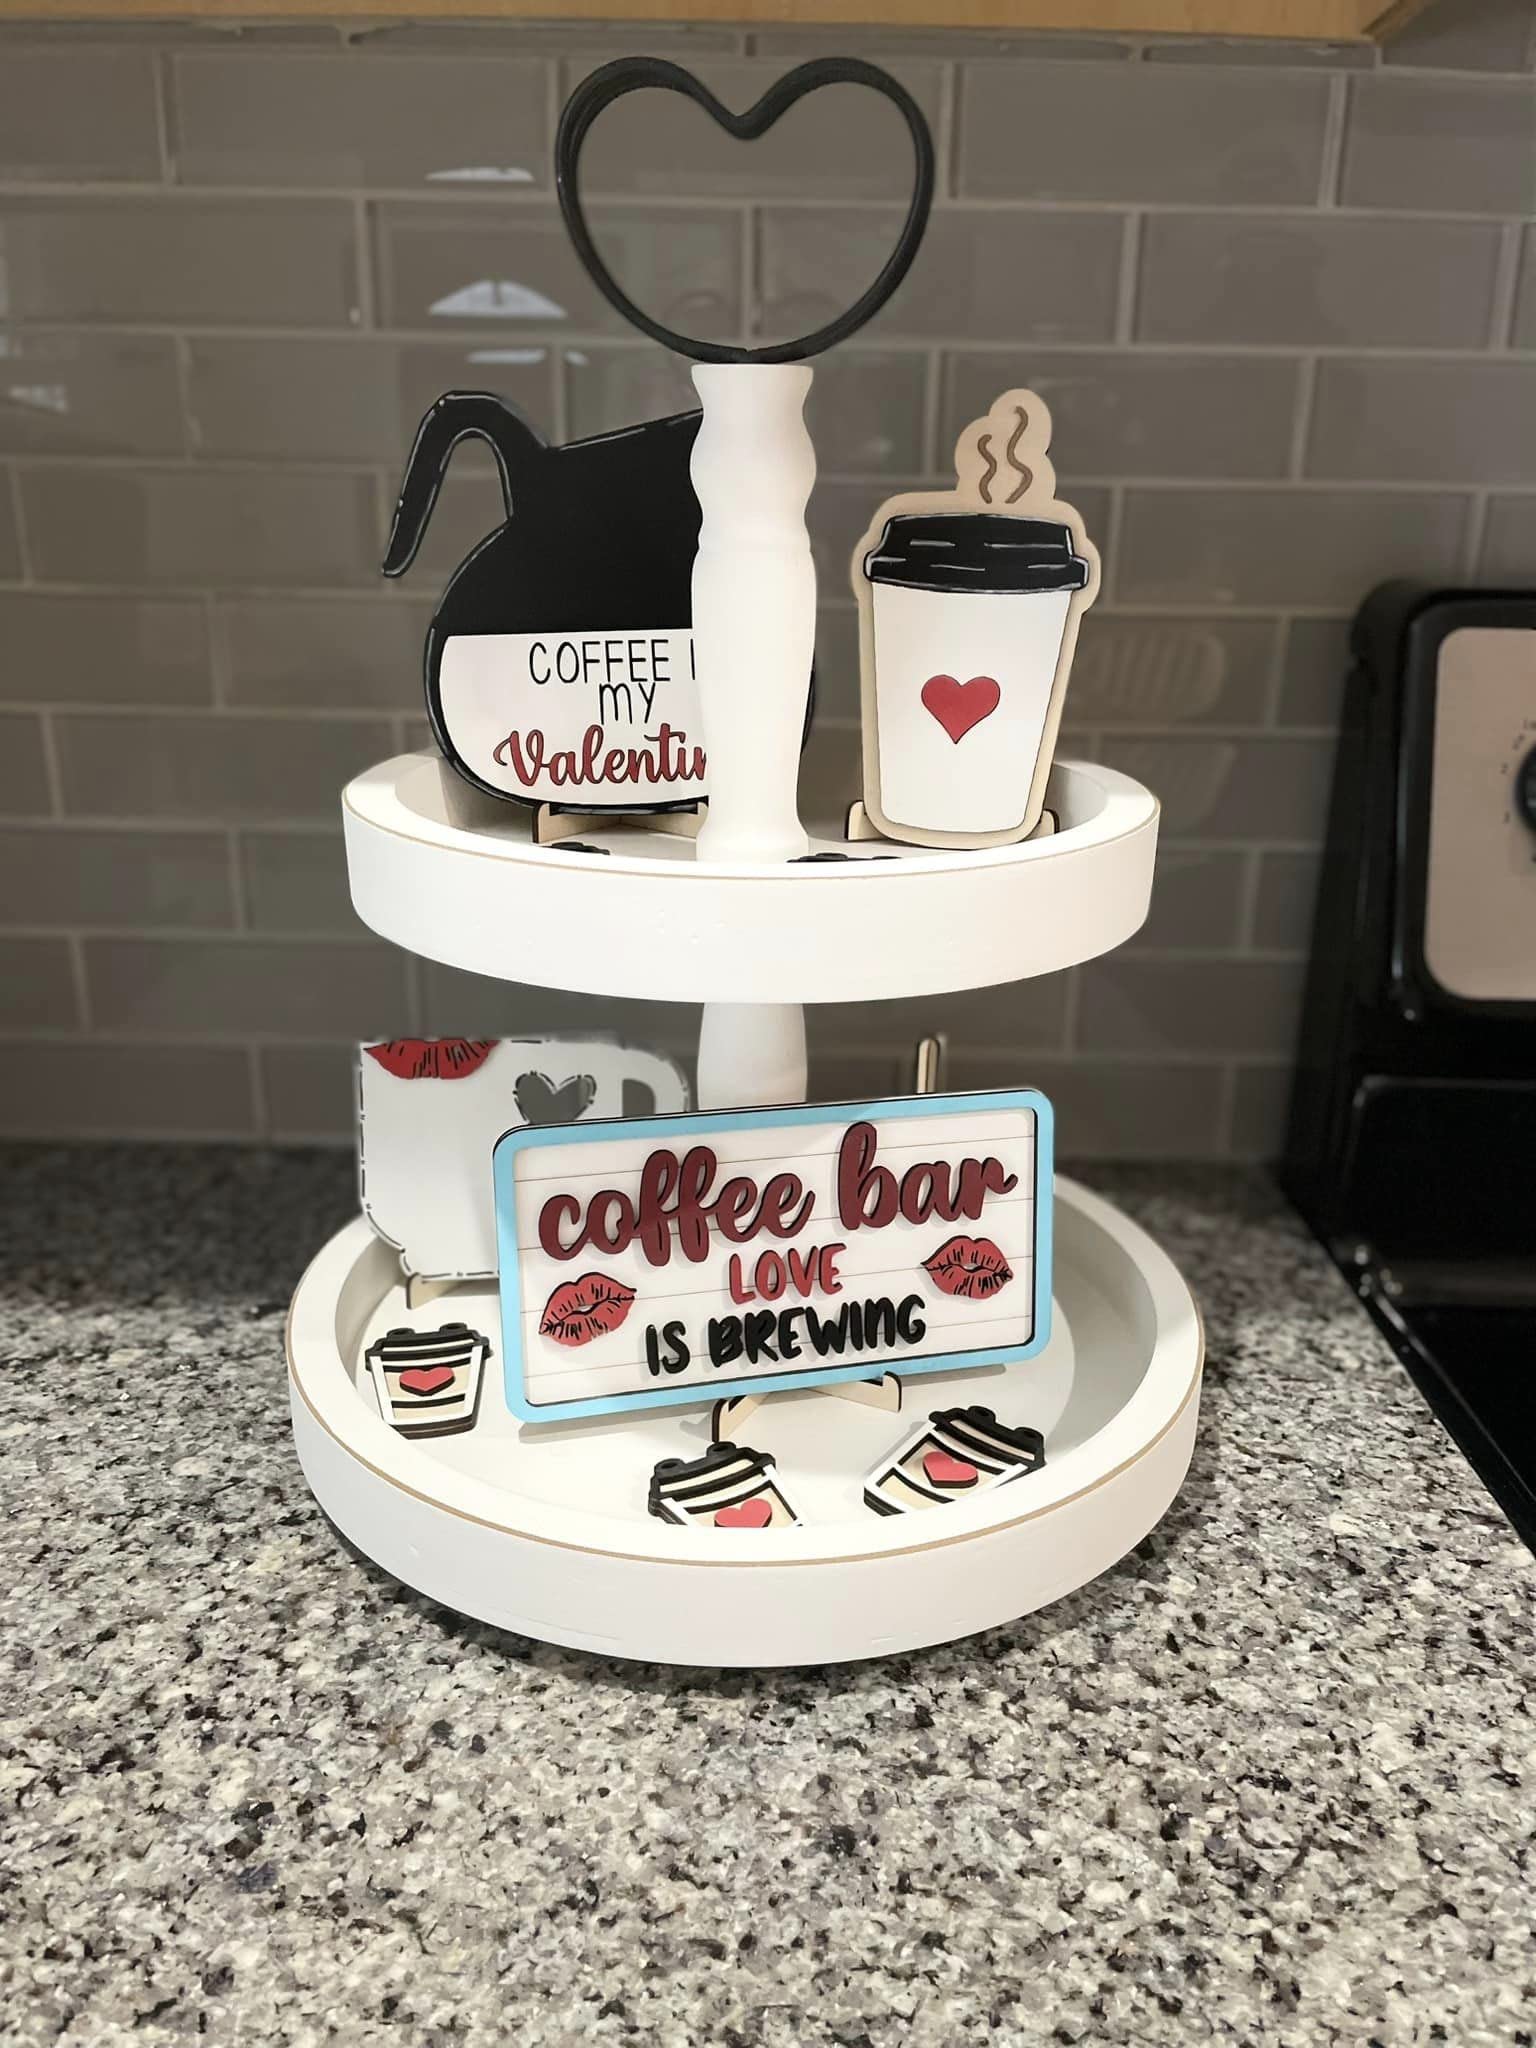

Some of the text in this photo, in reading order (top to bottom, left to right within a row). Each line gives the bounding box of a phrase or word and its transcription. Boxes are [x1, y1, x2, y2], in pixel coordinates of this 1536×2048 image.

[529, 638, 697, 685] COFFEE I
[538, 1121, 1018, 1267] coffee bar
[728, 1243, 847, 1305] LOVE
[645, 1294, 927, 1377] IS BREWING
